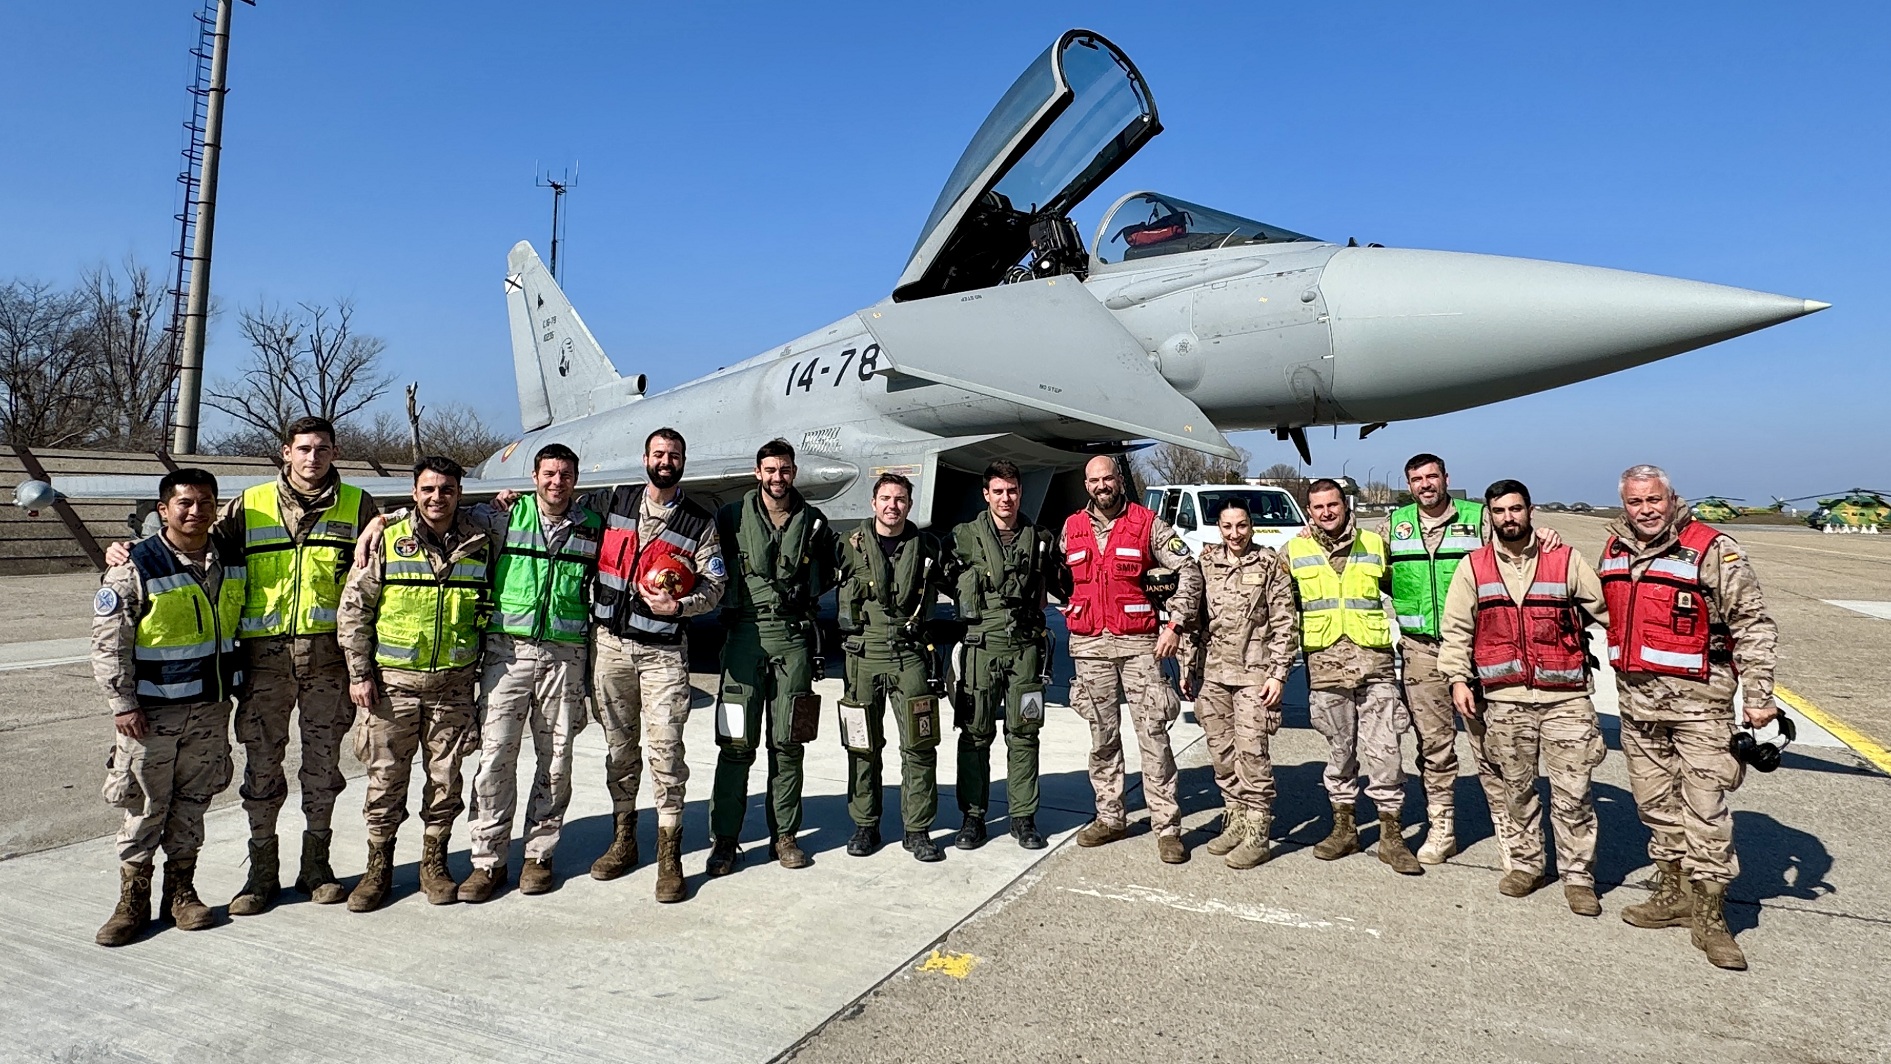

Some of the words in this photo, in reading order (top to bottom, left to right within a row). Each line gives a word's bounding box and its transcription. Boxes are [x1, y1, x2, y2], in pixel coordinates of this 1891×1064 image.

[786, 343, 881, 396] 14-78
[1039, 383, 1047, 391] NO
[1047, 385, 1063, 394] STEP
[1115, 562, 1139, 573] SMN
[1145, 582, 1176, 593] JANDRO
